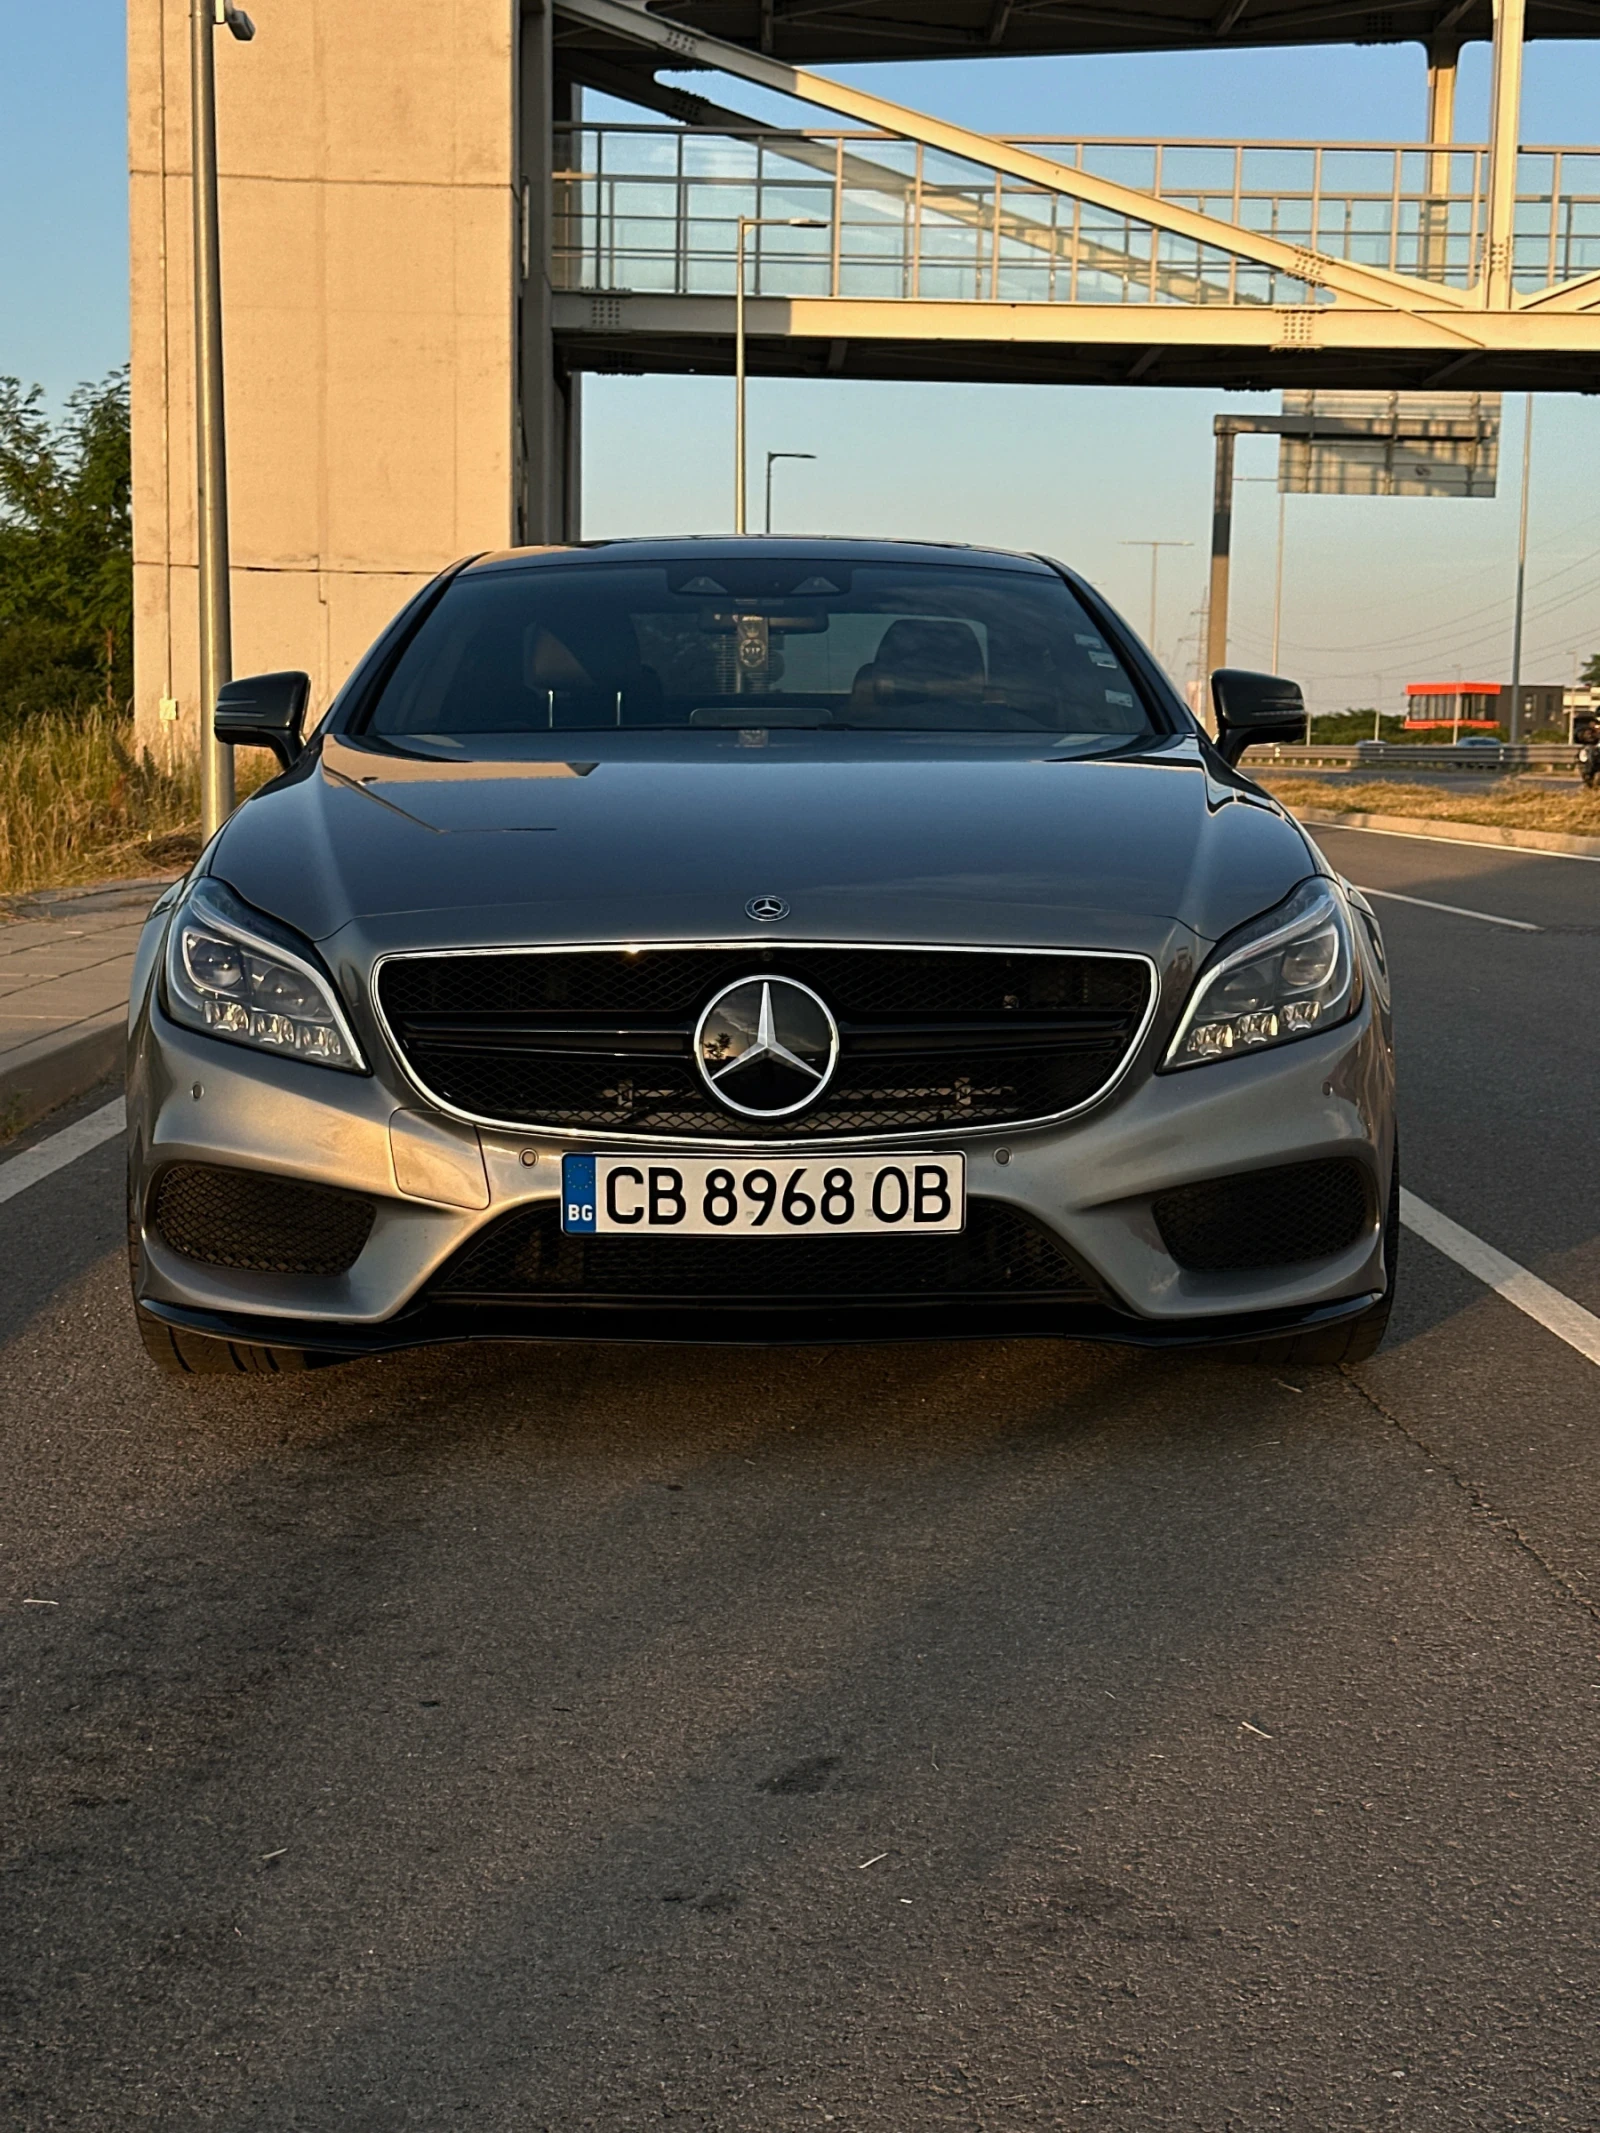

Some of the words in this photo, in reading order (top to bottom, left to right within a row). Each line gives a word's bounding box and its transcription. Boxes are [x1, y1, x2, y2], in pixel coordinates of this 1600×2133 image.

[744, 647, 761, 655] VIP
[606, 1166, 687, 1226] CB
[702, 1167, 855, 1226] 8968
[871, 1164, 952, 1224] OB
[568, 1204, 593, 1222] BG
